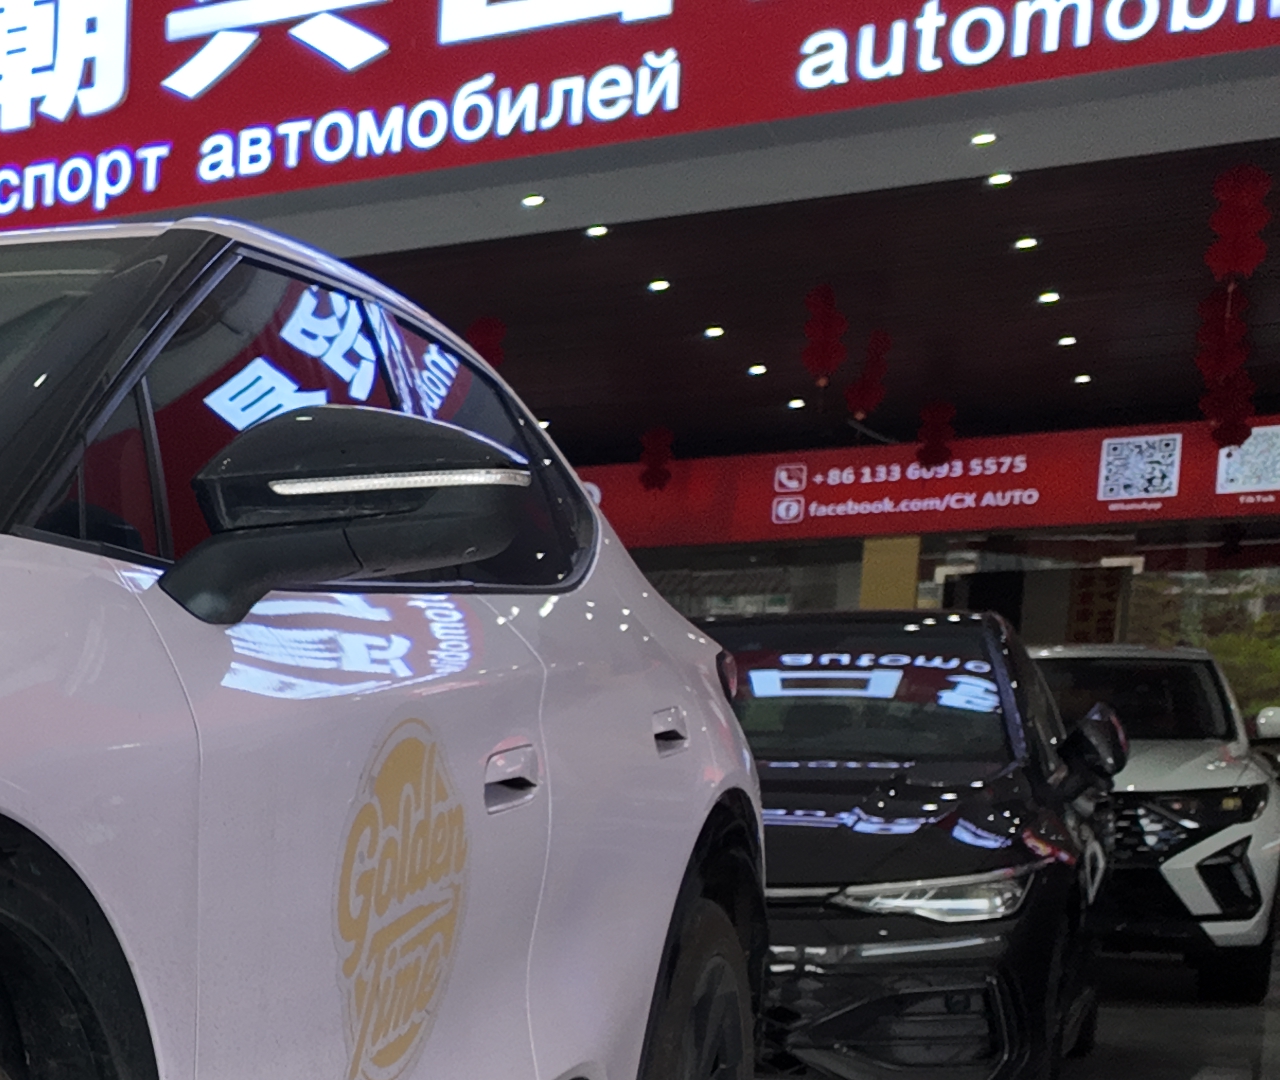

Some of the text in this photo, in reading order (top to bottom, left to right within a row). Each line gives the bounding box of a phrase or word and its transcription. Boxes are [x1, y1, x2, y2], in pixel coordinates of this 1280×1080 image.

[796, 0, 1280, 89] automob
[197, 48, 682, 182] автомобилей
[812, 466, 855, 485] +86
[861, 463, 901, 483] 133
[968, 454, 1028, 476] 5575
[980, 488, 1040, 507] AUTO
